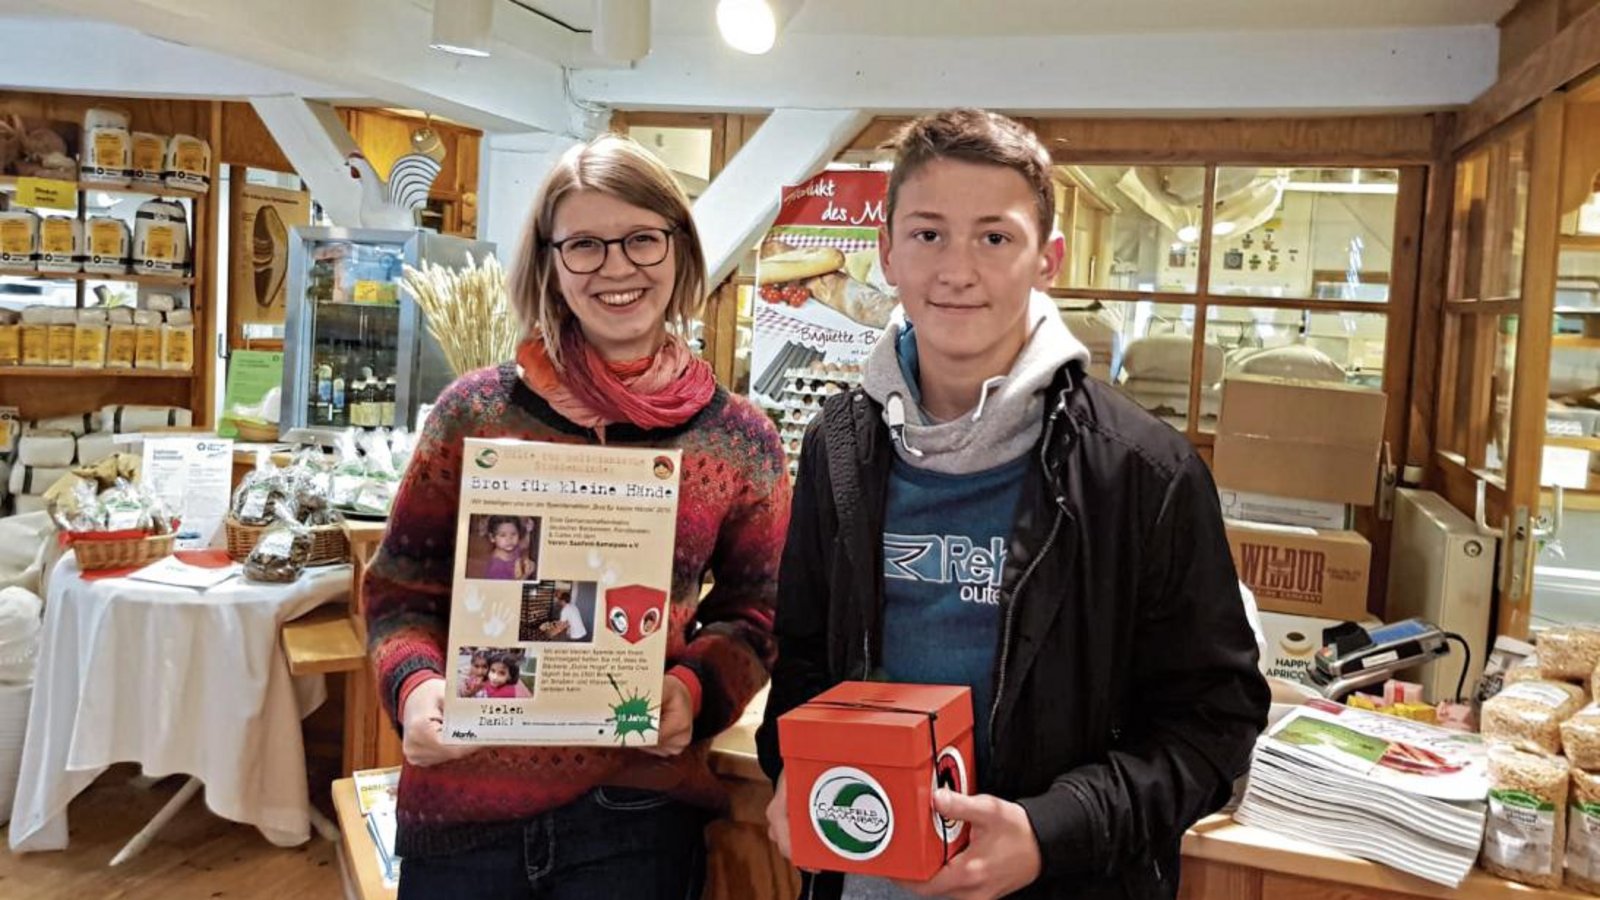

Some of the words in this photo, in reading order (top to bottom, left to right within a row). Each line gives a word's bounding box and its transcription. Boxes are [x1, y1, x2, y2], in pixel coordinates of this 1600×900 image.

[821, 200, 847, 222] des
[850, 200, 887, 225] M
[797, 327, 854, 347] Baguette
[471, 476, 511, 491] Brot
[521, 479, 549, 492] für
[559, 480, 617, 496] kleine
[626, 483, 674, 499] Hände
[945, 534, 1008, 586] Reh
[960, 585, 1001, 605] oute
[1275, 658, 1311, 668] HAPPY
[1266, 669, 1306, 679] APRICO
[481, 704, 524, 715] Vielen
[479, 716, 514, 727] Dank!
